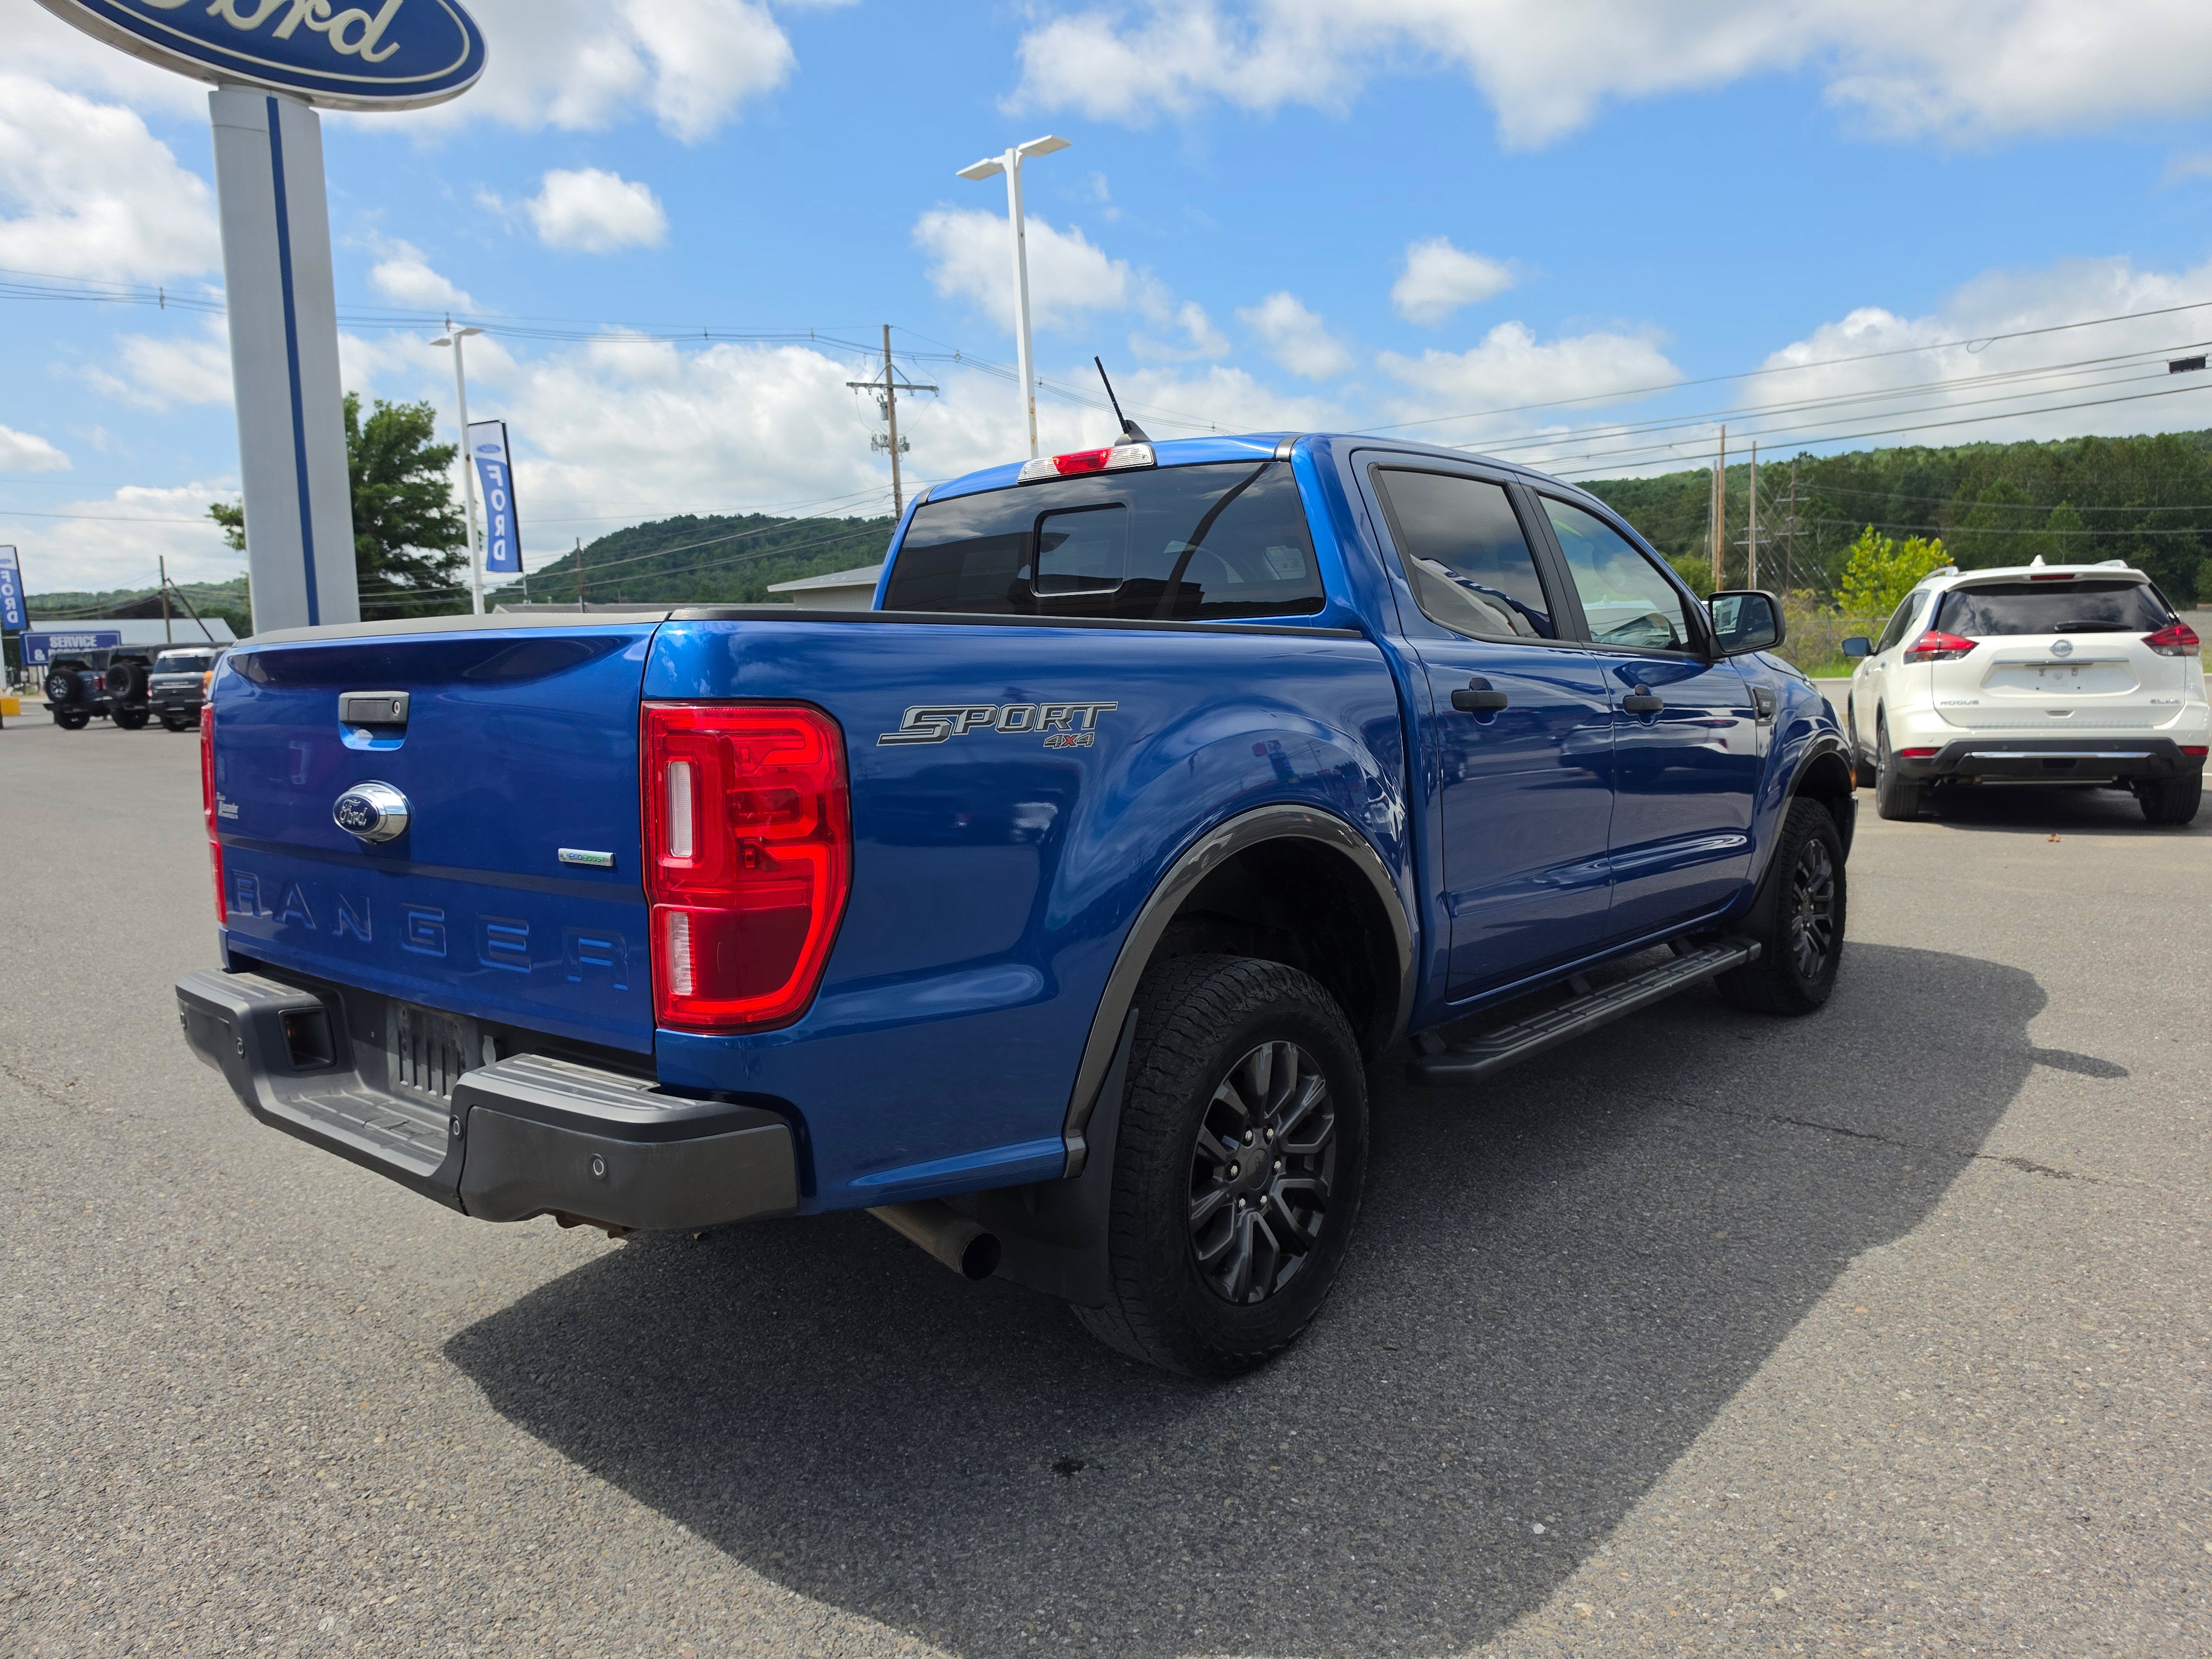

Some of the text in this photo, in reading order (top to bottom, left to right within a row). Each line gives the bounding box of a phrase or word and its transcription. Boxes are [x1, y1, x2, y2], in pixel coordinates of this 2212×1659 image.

[140, 0, 403, 62] ord
[34, 649, 45, 661] &
[49, 635, 97, 648] SERVICE
[876, 701, 1118, 747] SPORT
[340, 799, 368, 826] Ford
[226, 870, 629, 991] RANGER
